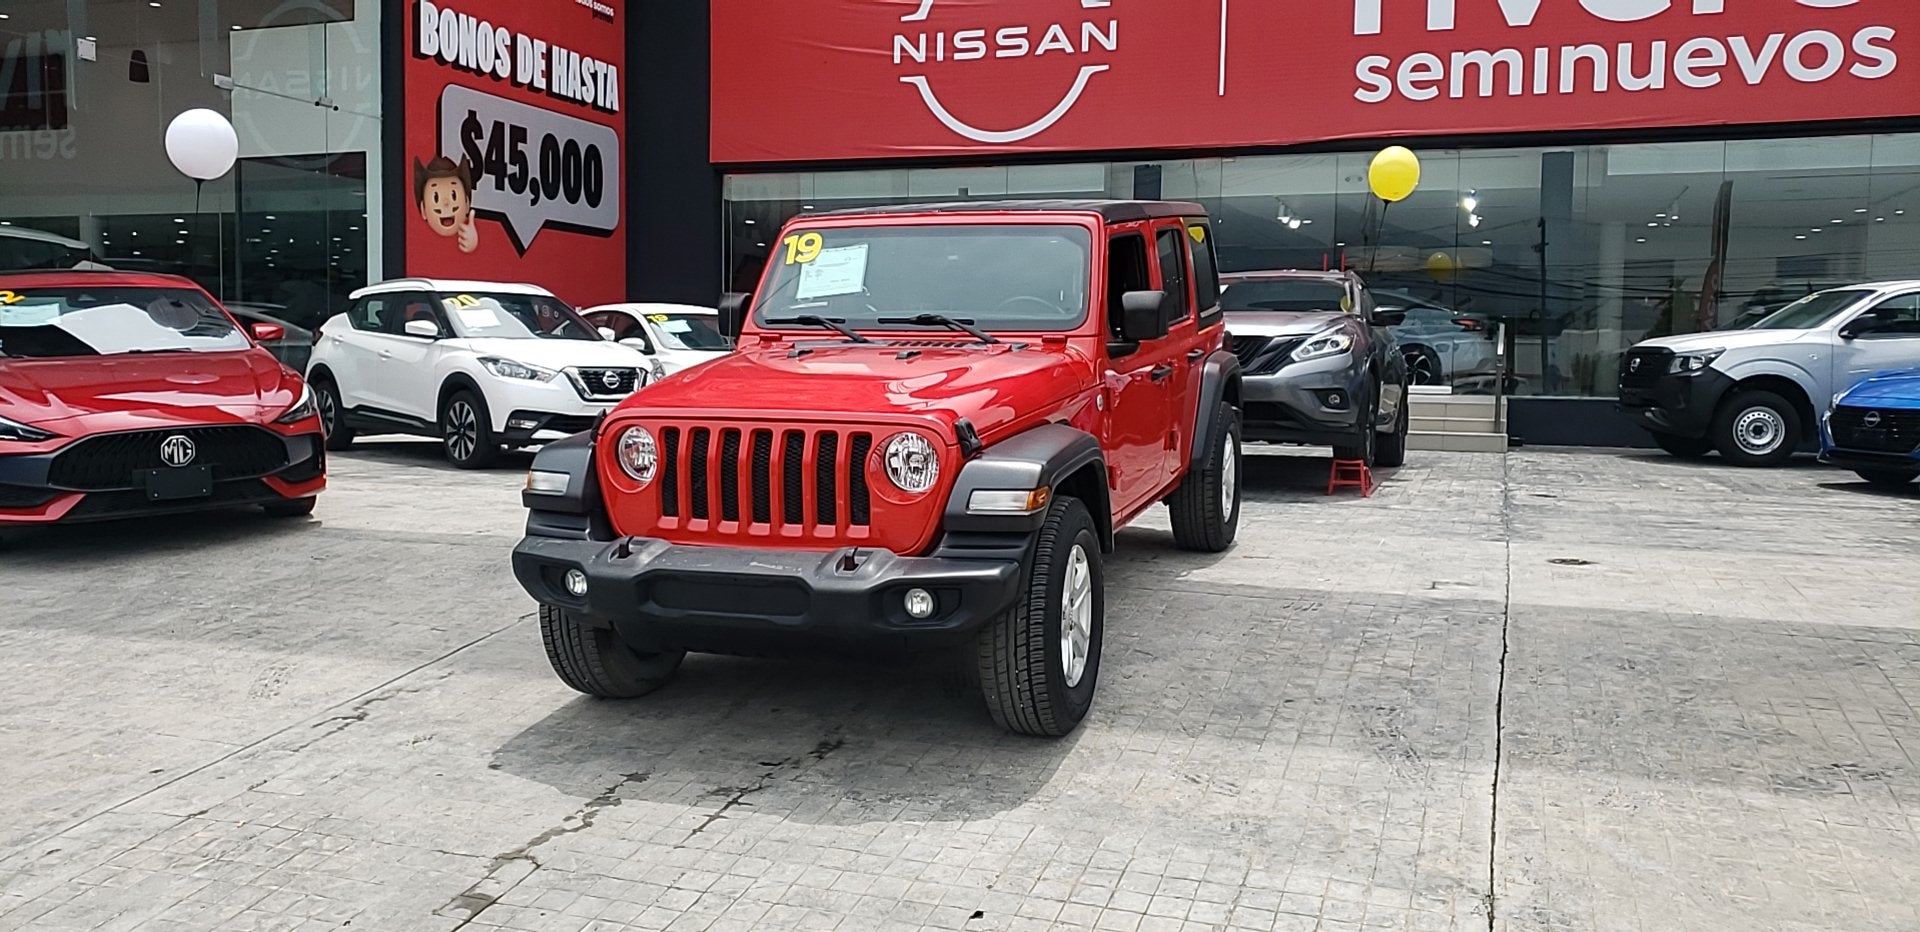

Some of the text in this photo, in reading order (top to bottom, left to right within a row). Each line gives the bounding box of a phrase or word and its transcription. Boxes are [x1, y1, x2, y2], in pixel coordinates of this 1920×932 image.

[420, 0, 619, 112] BONOS DE HASTA
[893, 20, 1117, 64] NISSAN
[1353, 25, 1897, 103] seminuevos
[460, 109, 604, 209] $45,000
[783, 232, 823, 265] 19
[441, 294, 480, 310] 20
[163, 438, 193, 465] MG
